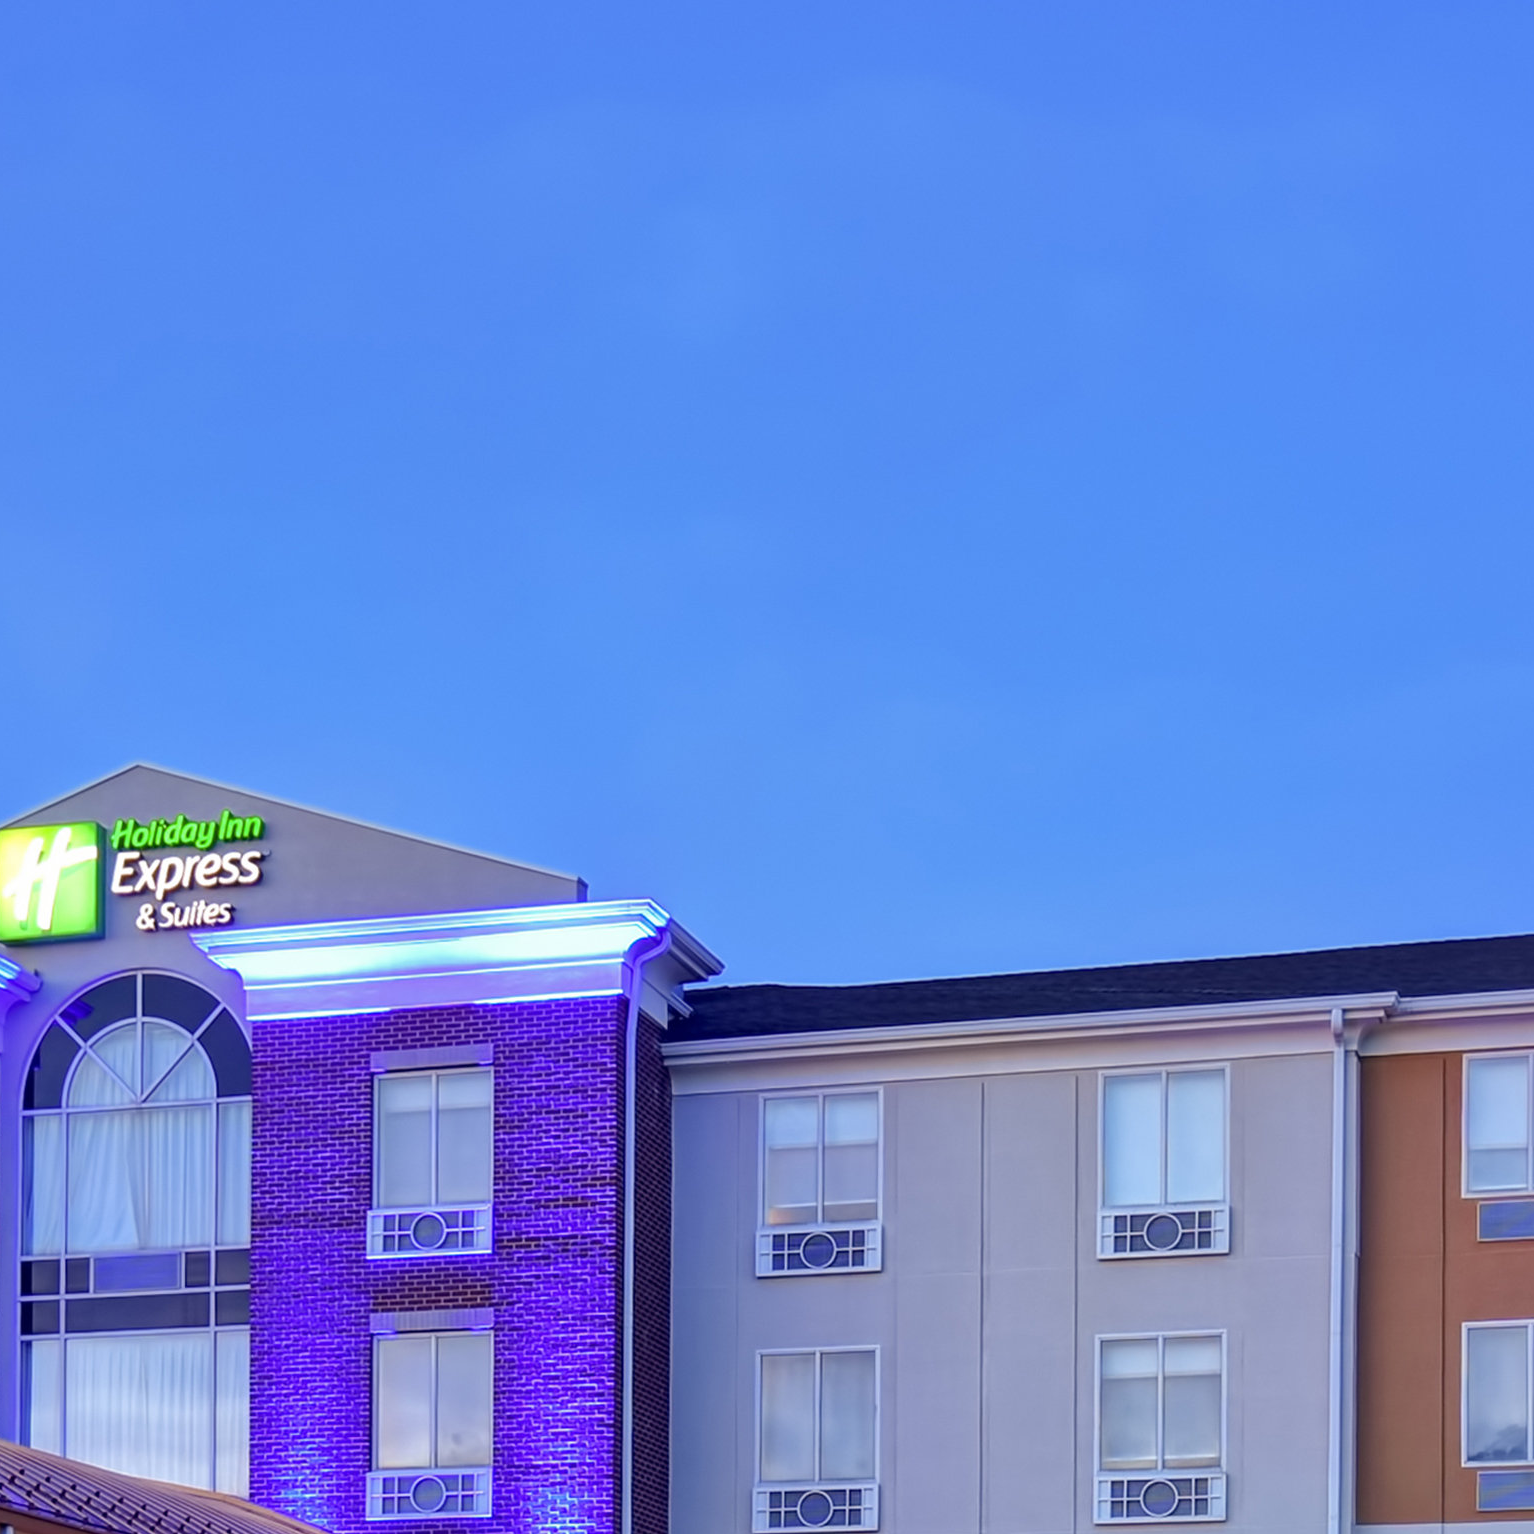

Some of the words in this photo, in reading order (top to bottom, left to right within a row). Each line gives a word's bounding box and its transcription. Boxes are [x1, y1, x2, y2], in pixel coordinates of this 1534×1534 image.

[111, 814, 217, 850] Holiday
[218, 809, 263, 842] Inn
[111, 850, 262, 901] Express
[135, 903, 156, 931] &
[158, 900, 232, 928] Suites
